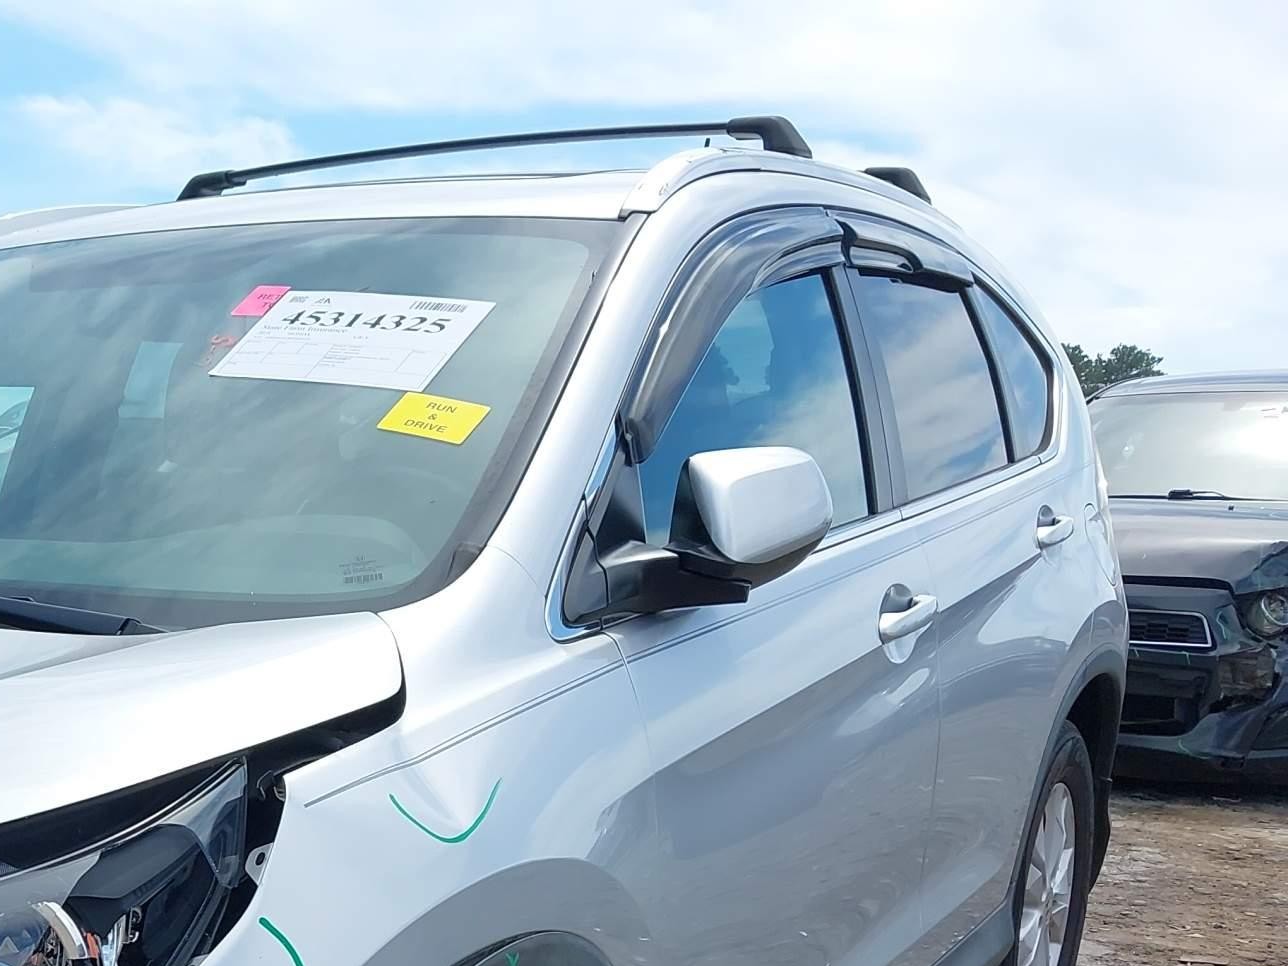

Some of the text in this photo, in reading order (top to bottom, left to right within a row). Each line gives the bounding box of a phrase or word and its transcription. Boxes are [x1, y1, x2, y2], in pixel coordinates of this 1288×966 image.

[281, 309, 453, 334] 45314325
[425, 401, 457, 413] RUN
[427, 413, 438, 421] &
[403, 419, 449, 433] DRIVE
